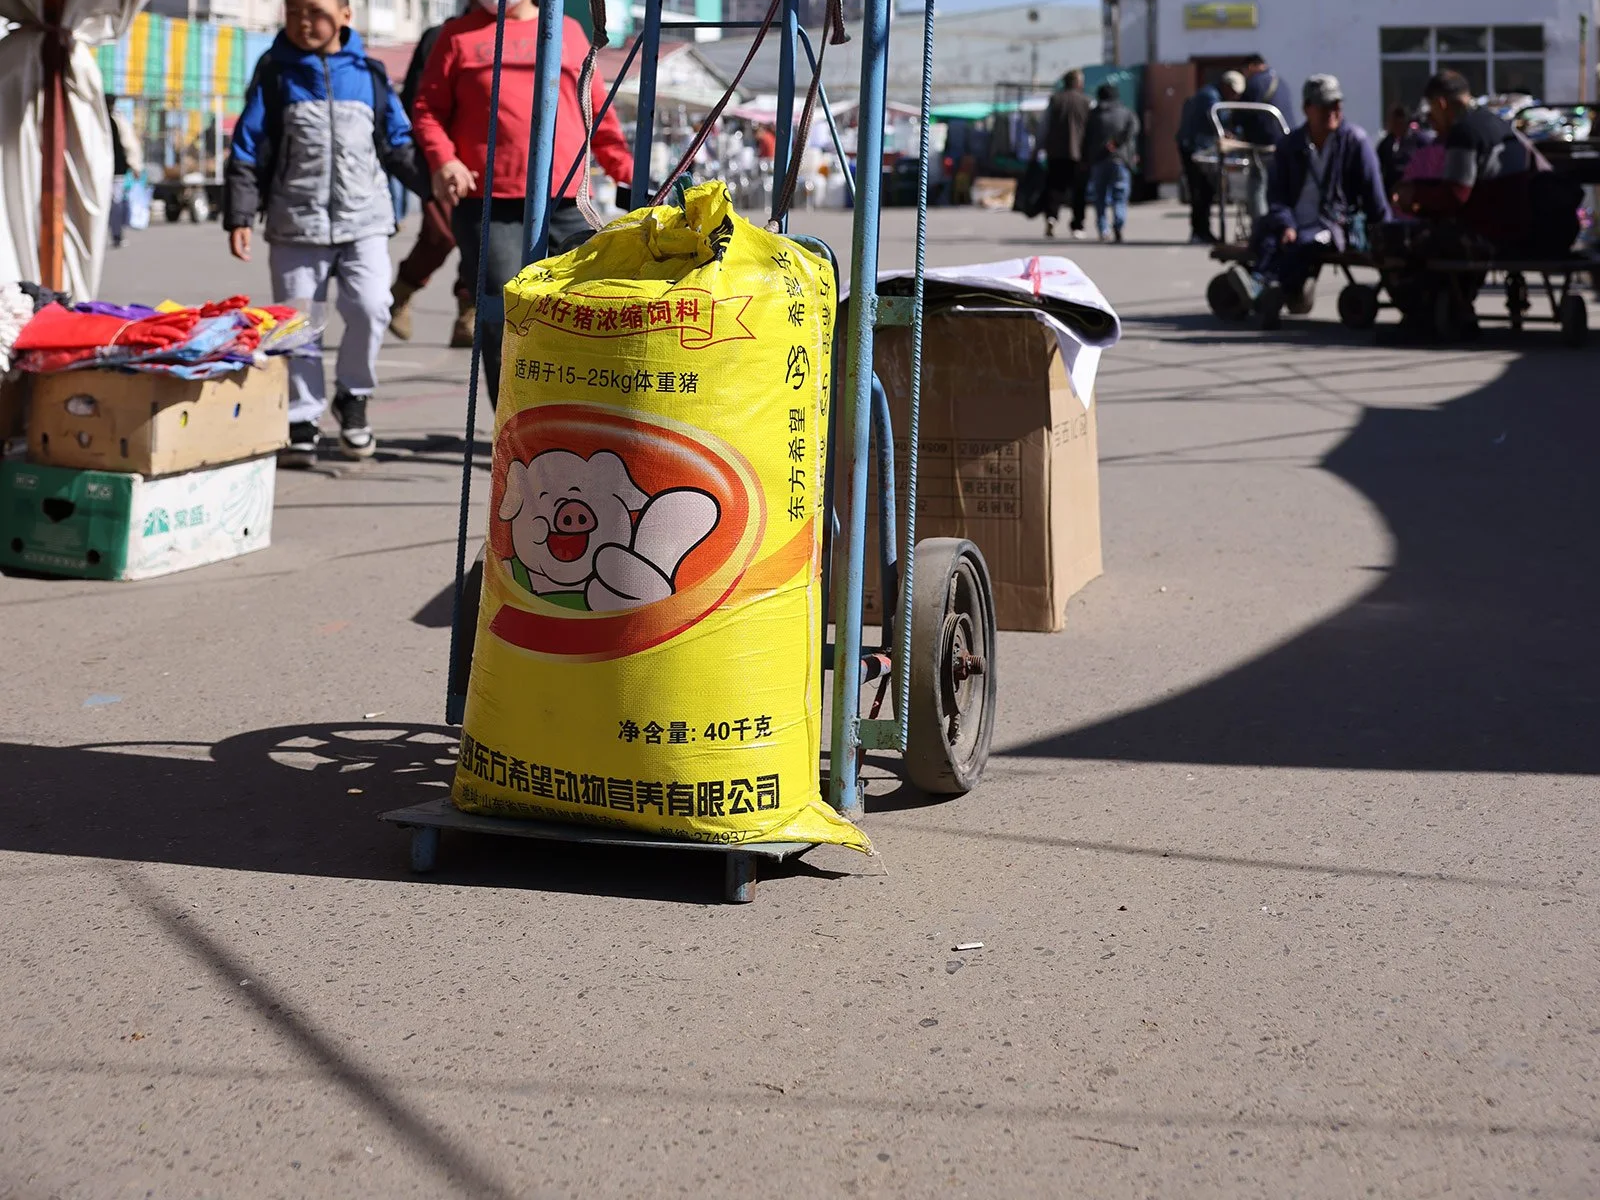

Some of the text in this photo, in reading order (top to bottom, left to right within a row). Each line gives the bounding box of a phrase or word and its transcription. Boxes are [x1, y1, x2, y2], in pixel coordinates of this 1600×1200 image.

[514, 358, 699, 394] 适用于15-25kg体重猪
